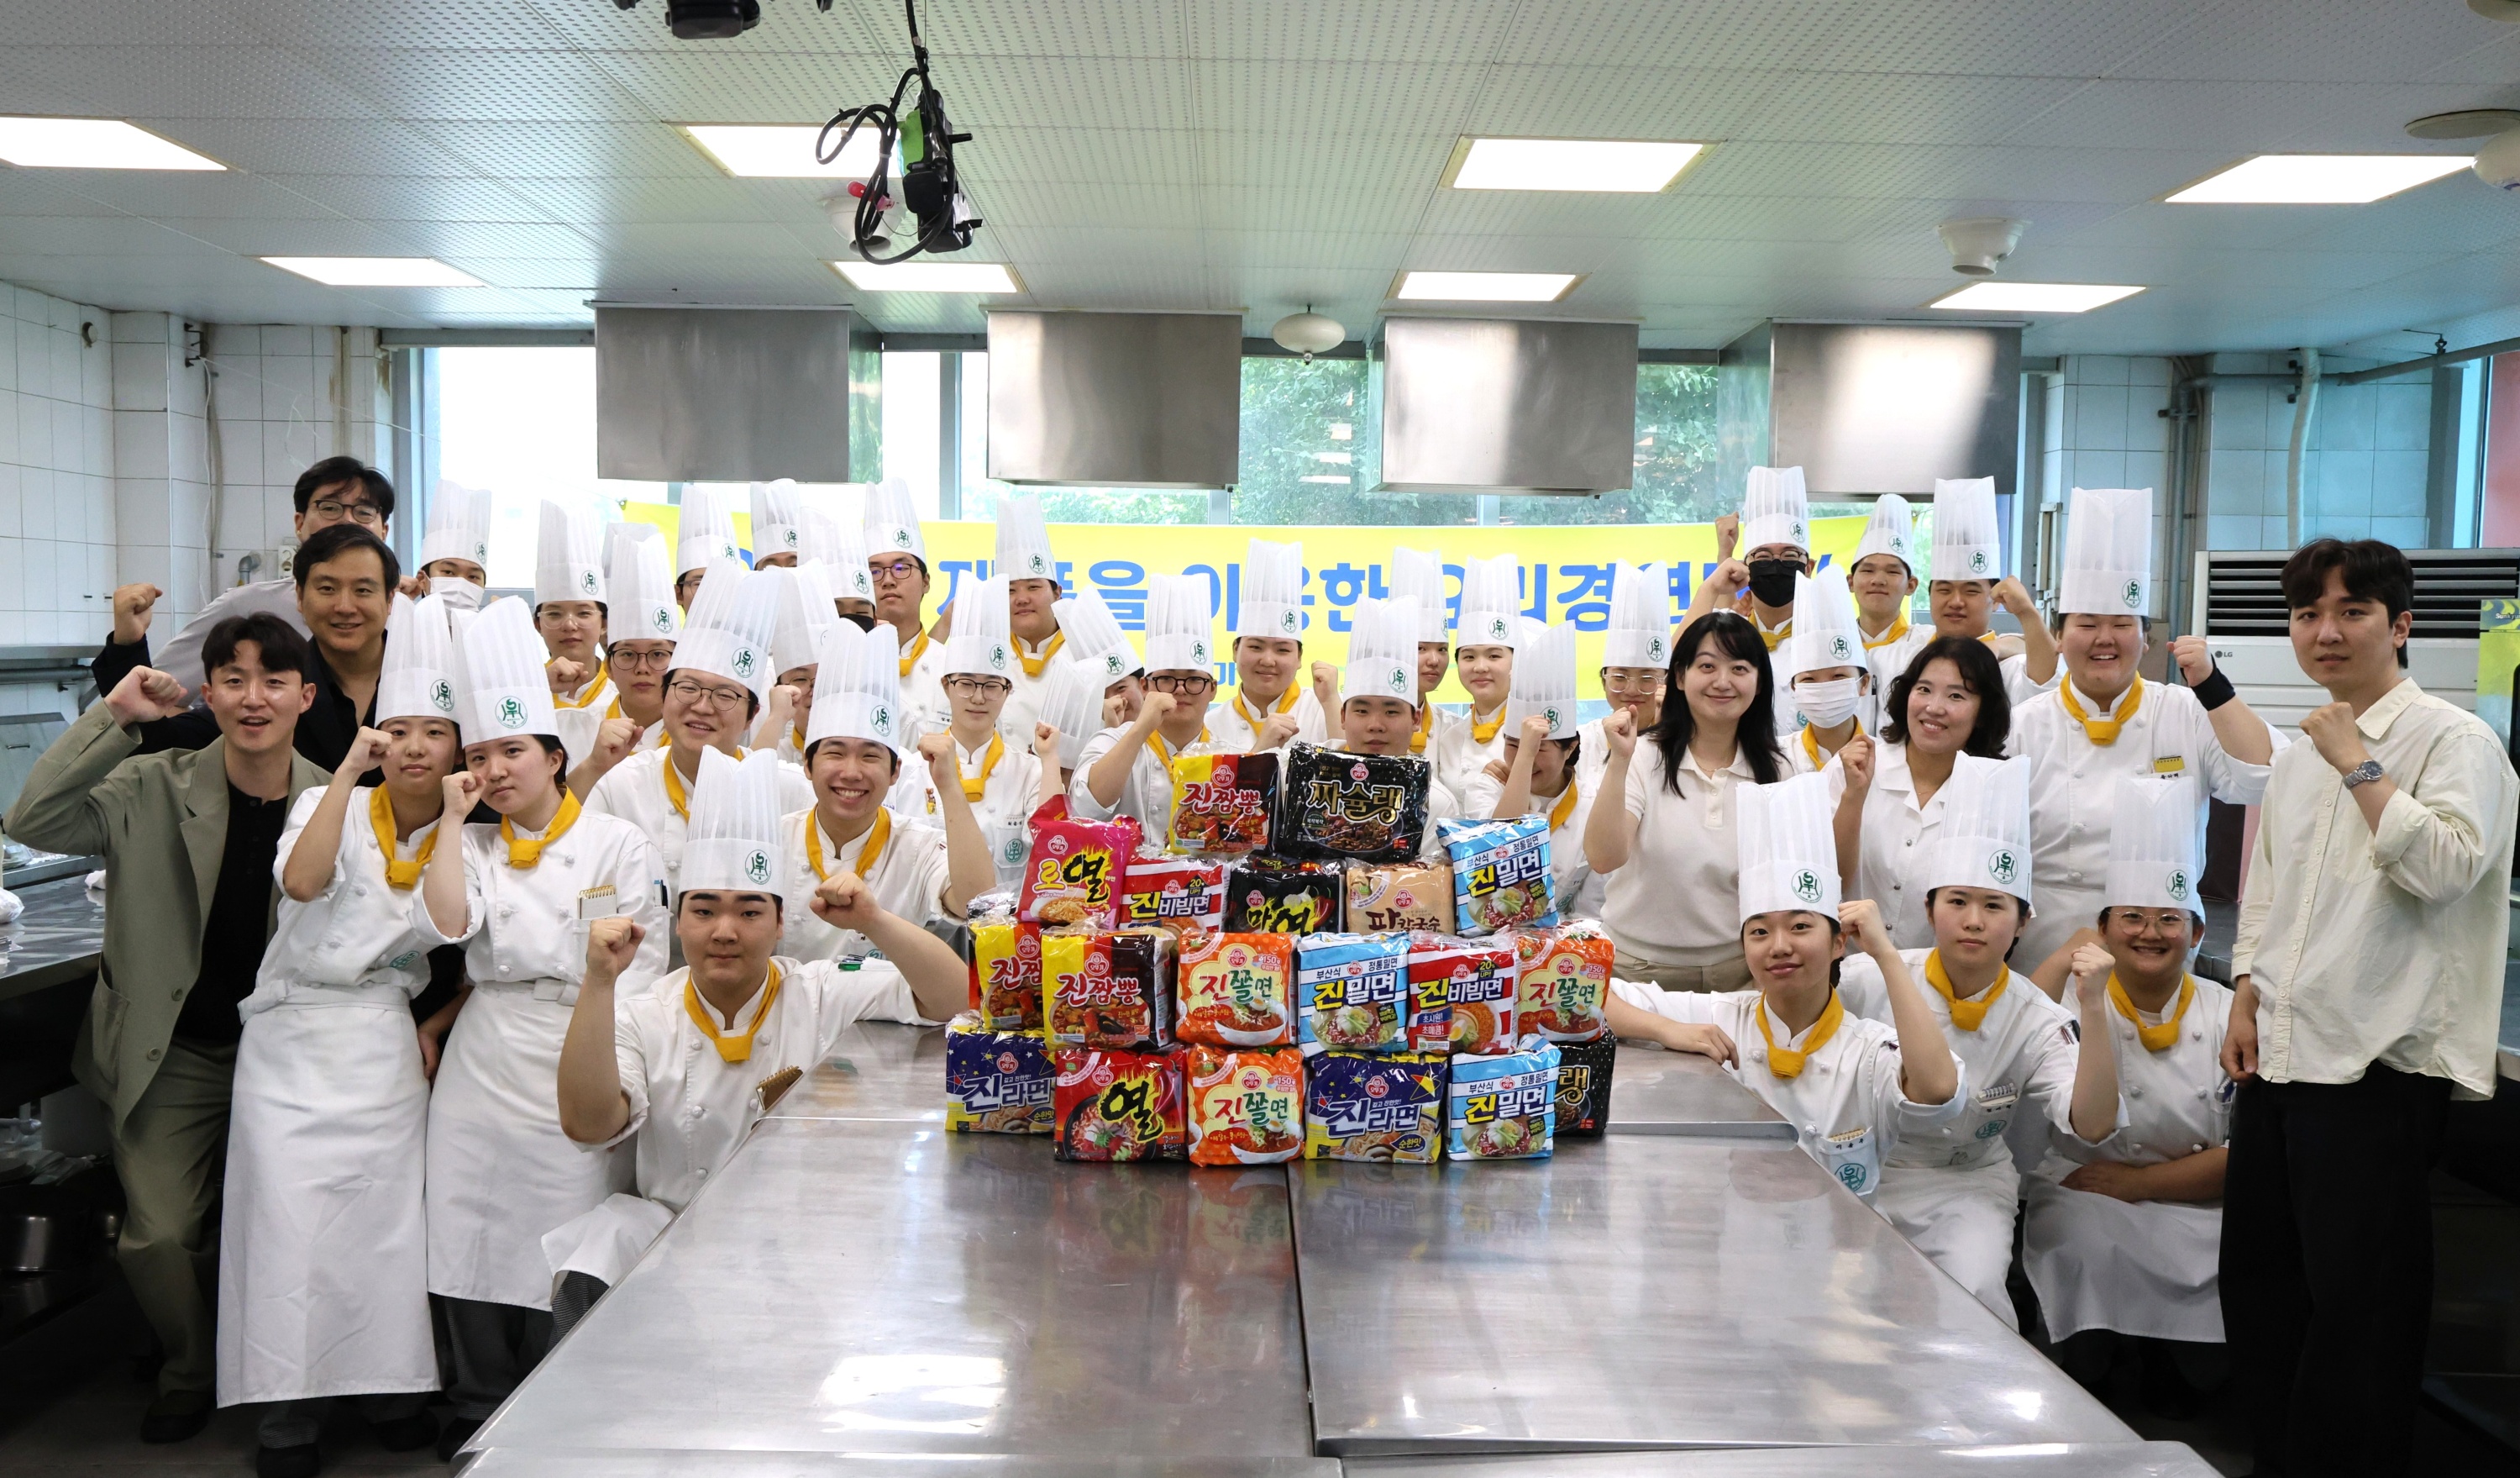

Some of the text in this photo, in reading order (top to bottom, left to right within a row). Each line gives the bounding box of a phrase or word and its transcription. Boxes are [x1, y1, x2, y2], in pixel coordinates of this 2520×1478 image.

[1179, 781, 1263, 815] 진짬뽕
[1306, 781, 1405, 825] 짜슐랭
[1467, 835, 1540, 867] 부산식 정통밀면
[1467, 849, 1541, 897] 진밀면
[1129, 891, 1211, 918] 진비빔면
[988, 955, 1042, 990] 진짬
[1262, 956, 1281, 965] 150g
[1316, 957, 1398, 980] 부산식 정통밀면
[1054, 972, 1142, 1007] 진짬뽕
[1199, 969, 1273, 1003] 진쫄면
[1314, 970, 1397, 1011] 진밀면
[1417, 977, 1504, 1008] 진비빔면
[1529, 977, 1596, 1008] 진쫄면
[1421, 1024, 1444, 1035] 초매콤!
[1423, 1013, 1443, 1023] 초시원!
[962, 1073, 1051, 1114] 진라면
[1469, 1071, 1548, 1093] 부산식 정통밀면
[1033, 1110, 1055, 1121] 순한맛
[1099, 1081, 1164, 1142] 열
[1213, 1092, 1288, 1125] 진쫄면
[1326, 1097, 1422, 1139] 진라면
[1465, 1086, 1547, 1124] 진밀면
[1399, 1138, 1422, 1149] 순한맛
